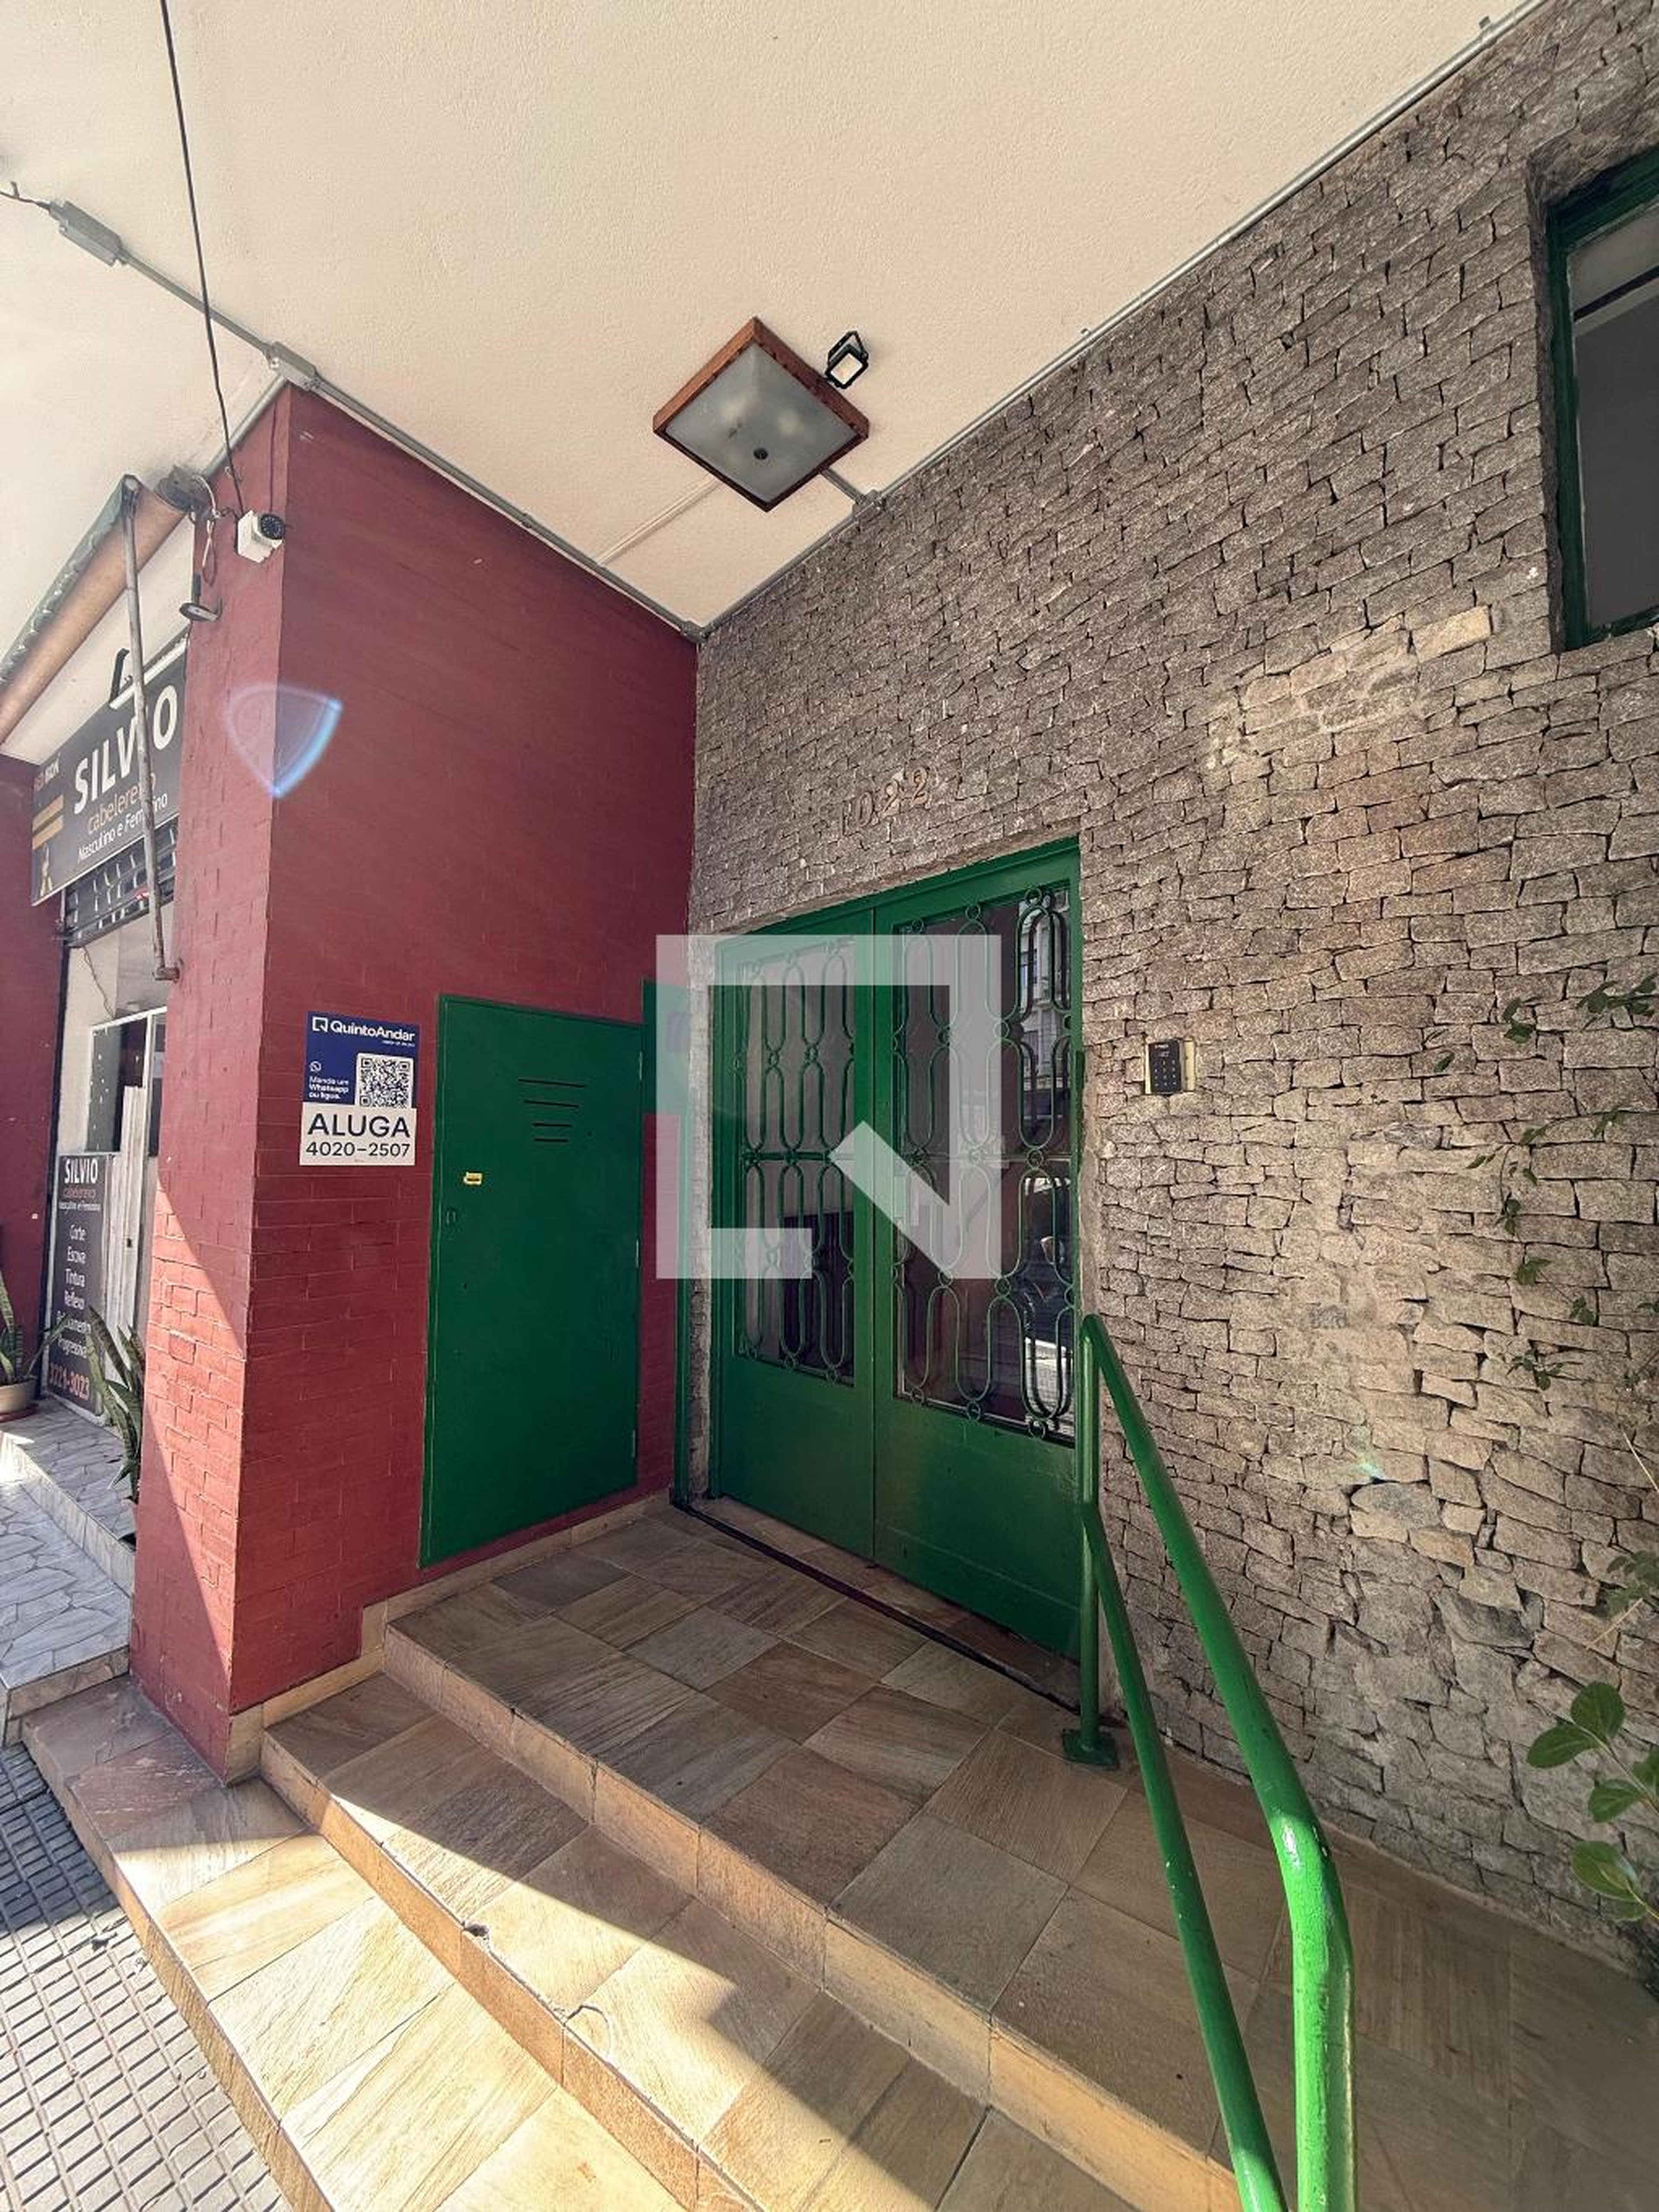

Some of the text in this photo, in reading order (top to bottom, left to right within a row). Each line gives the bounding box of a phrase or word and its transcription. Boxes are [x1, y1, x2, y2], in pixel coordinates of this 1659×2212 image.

[74, 685, 178, 814] SILVO
[88, 773, 156, 835] cabelereo
[117, 823, 124, 837] e
[124, 793, 168, 832] Femino
[330, 1020, 416, 1041] QuintoAndar
[308, 1113, 410, 1138] ALUGA
[306, 1142, 410, 1157] 4020-2507
[64, 1158, 98, 1184] SILVIO
